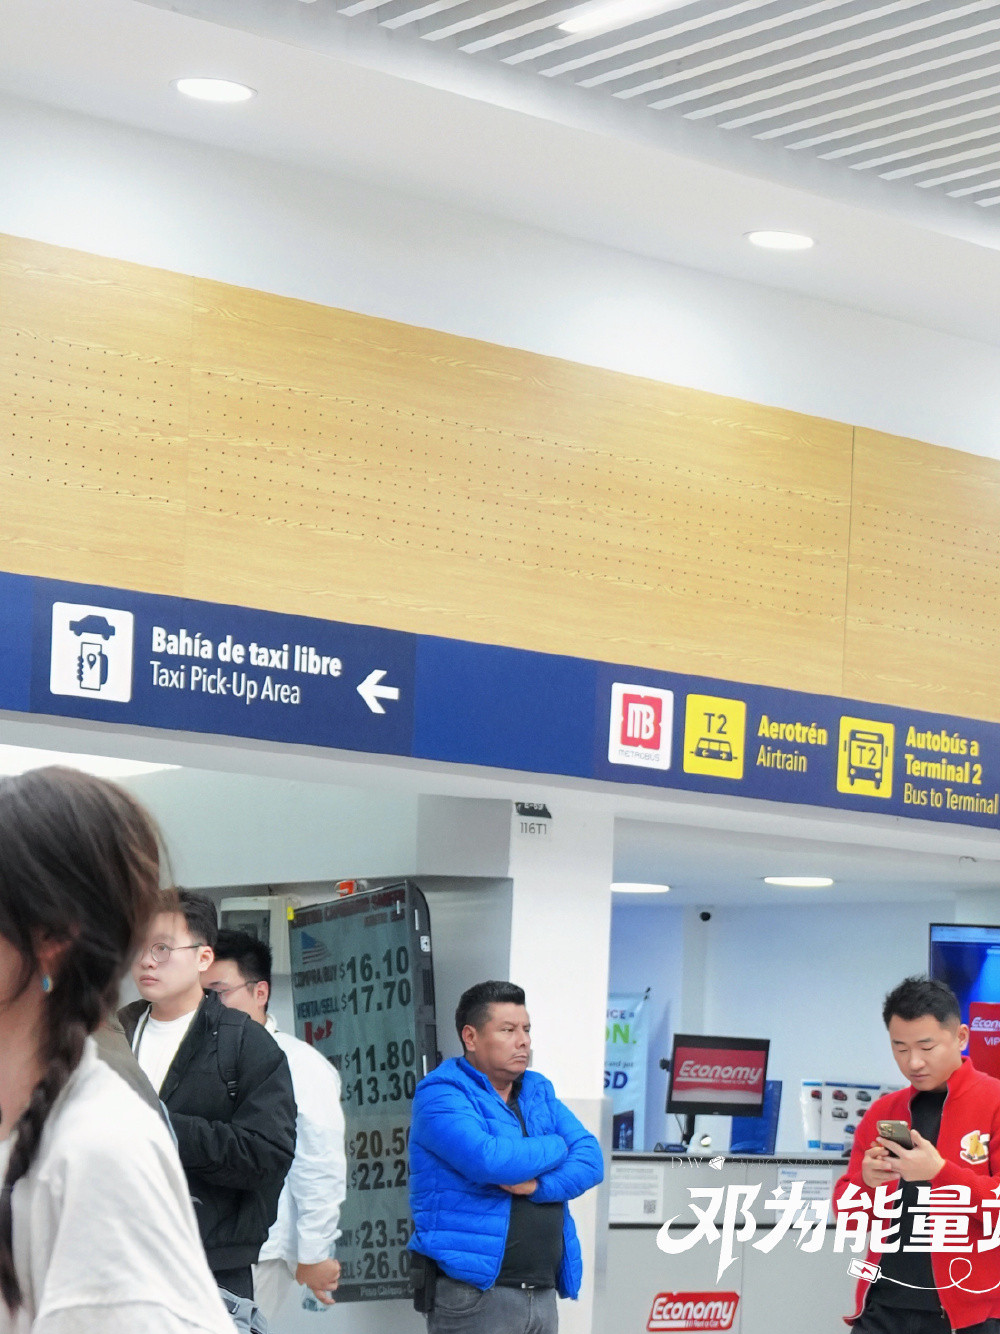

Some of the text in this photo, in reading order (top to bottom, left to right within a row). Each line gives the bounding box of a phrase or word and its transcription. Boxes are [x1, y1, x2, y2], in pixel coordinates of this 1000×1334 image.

[152, 626, 342, 677] Bahía de taxi libre
[150, 661, 300, 705] Taxi Pick-Up Area
[703, 713, 727, 735] T2
[758, 715, 828, 745] Aerotrén
[856, 745, 877, 766] T2
[905, 726, 980, 757] Autobús a
[756, 745, 807, 772] Airtrain
[905, 754, 982, 785] Terminal 2
[904, 783, 927, 806] Bus
[930, 788, 943, 808] to
[945, 788, 999, 815] Terminal
[345, 1039, 415, 1074] $11.80
[984, 1036, 1000, 1046] VIP
[346, 1070, 416, 1106] $13.30
[678, 1060, 762, 1085] Economy
[352, 1159, 411, 1191] $22.2
[355, 1218, 415, 1249] $23.5
[652, 1297, 735, 1328] Economy
